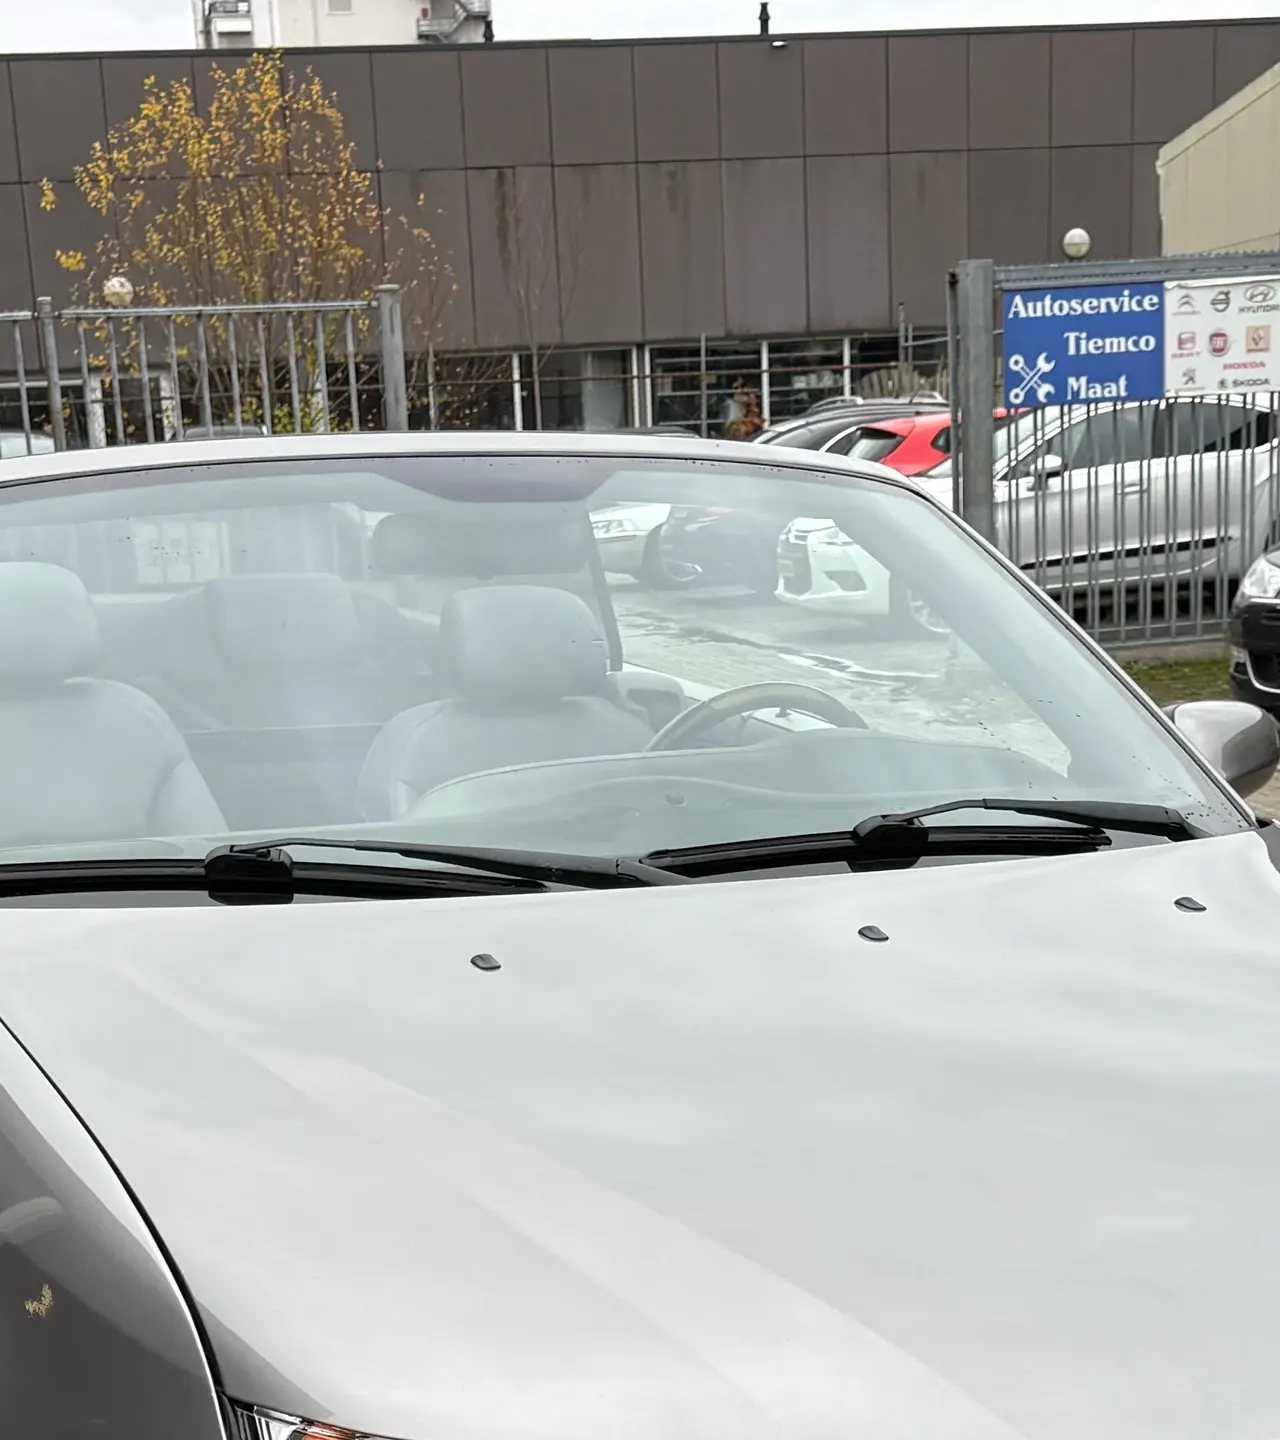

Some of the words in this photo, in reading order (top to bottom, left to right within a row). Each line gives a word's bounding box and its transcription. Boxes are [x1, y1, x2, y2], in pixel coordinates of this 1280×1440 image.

[1008, 289, 1160, 319] Autoservice
[1063, 331, 1156, 356] Tiemco
[1222, 361, 1267, 371] HONDA
[1066, 374, 1129, 401] Maat
